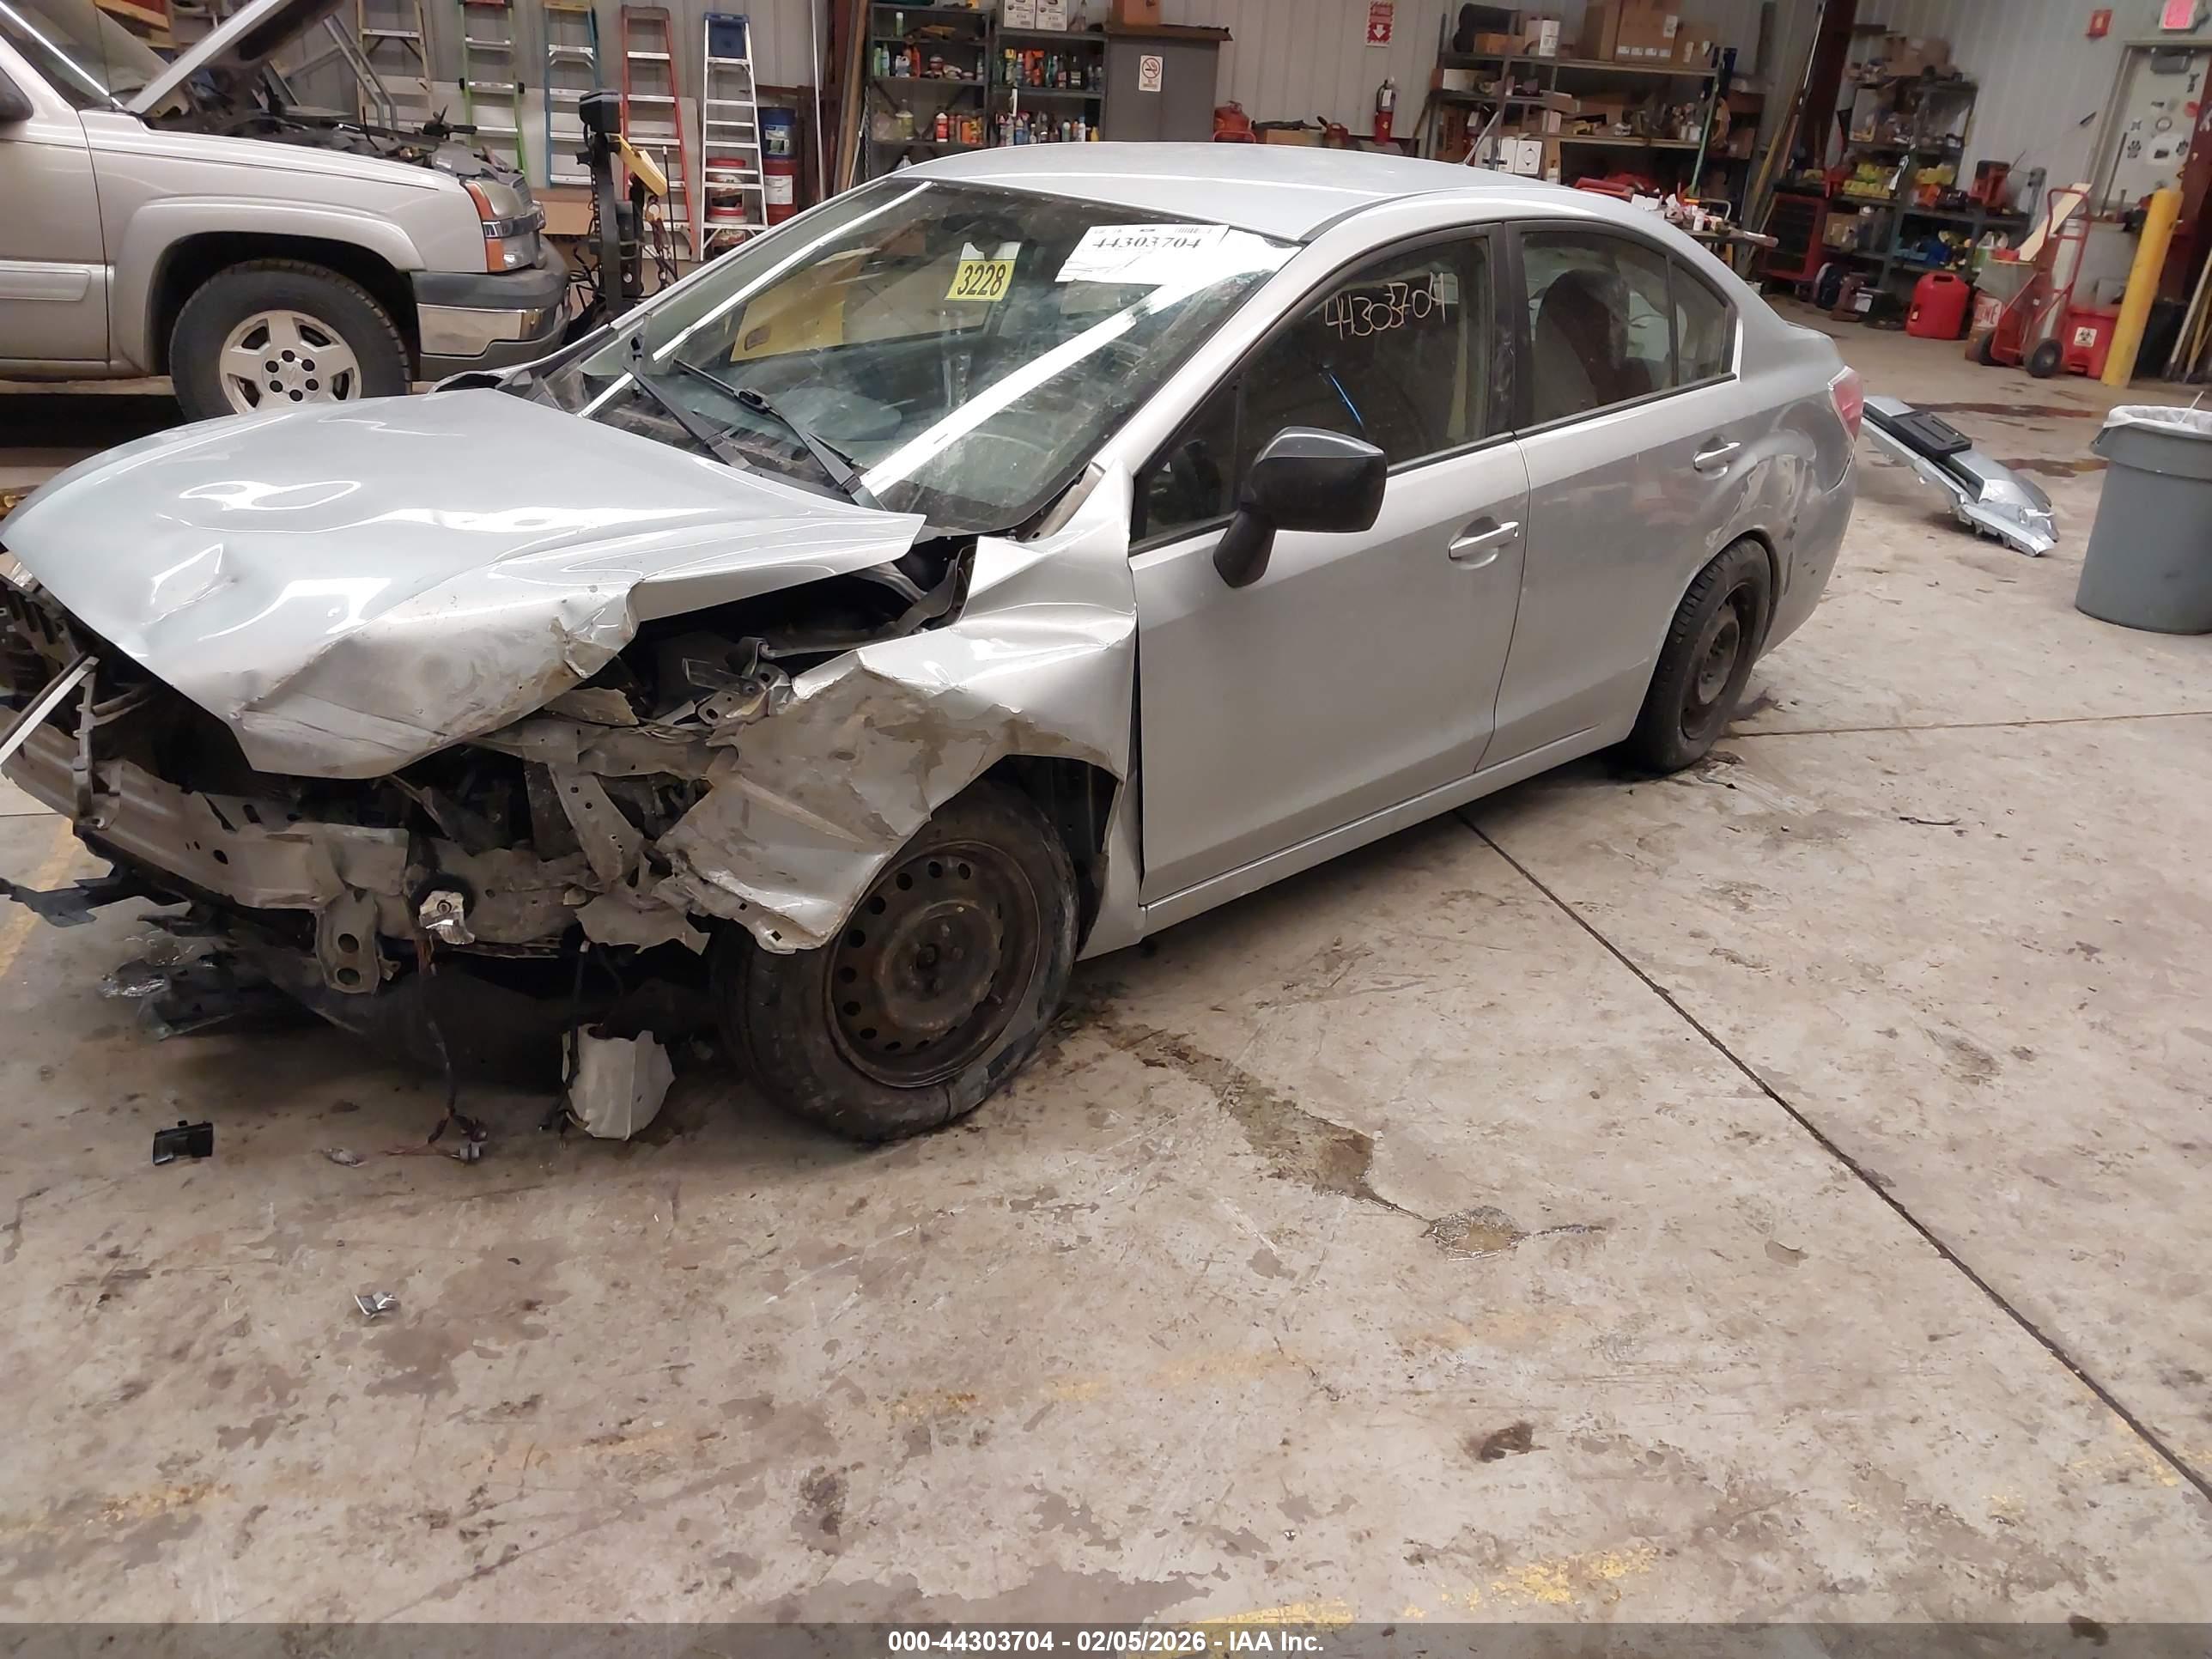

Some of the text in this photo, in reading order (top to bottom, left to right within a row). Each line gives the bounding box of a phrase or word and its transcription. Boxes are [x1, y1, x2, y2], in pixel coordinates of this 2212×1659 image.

[1091, 236, 1202, 249] 44303704
[957, 264, 1006, 296] 3228
[1324, 271, 1447, 341] 44303704
